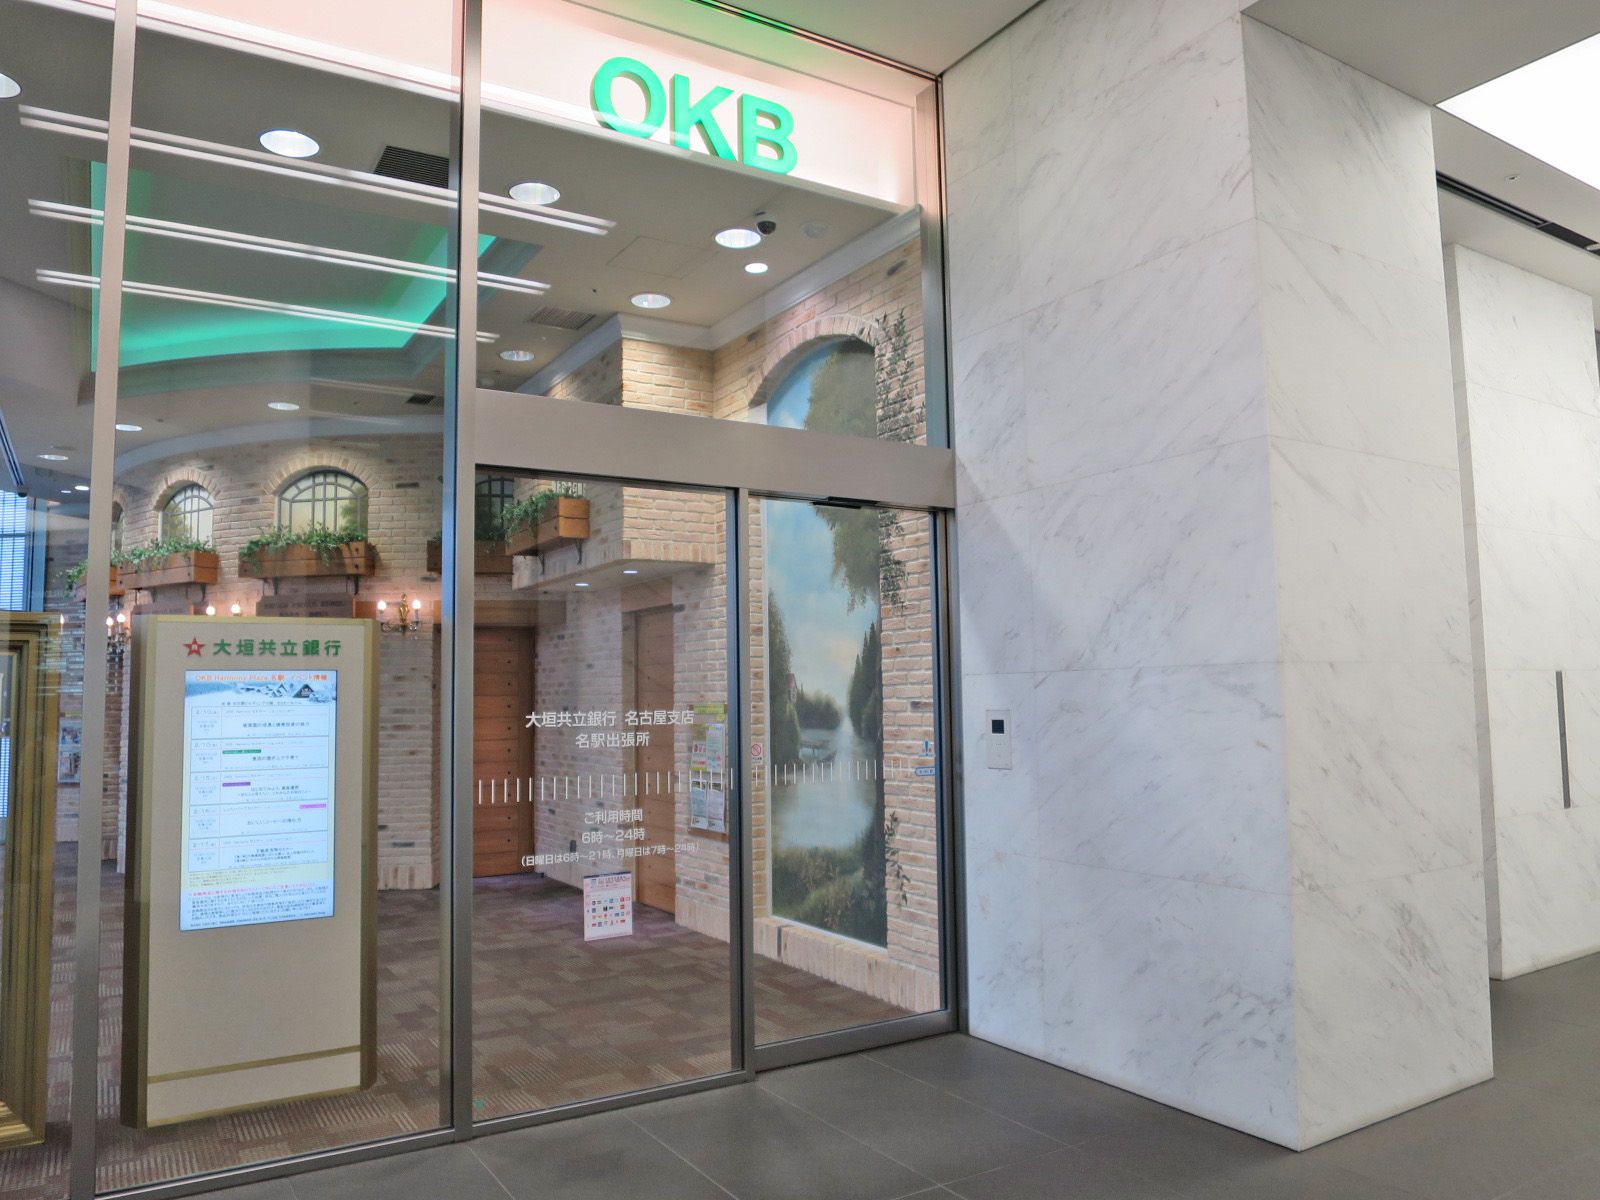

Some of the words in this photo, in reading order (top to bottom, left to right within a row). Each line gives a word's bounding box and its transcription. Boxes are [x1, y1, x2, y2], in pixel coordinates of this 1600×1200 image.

[590, 56, 798, 174] OKB
[213, 639, 342, 657] 大垣共立銀行
[525, 711, 617, 728] 大垣共立銀行
[625, 710, 695, 726] 名古屋支店
[575, 732, 651, 748] 名駅出張所
[584, 808, 643, 825] ご利用時間
